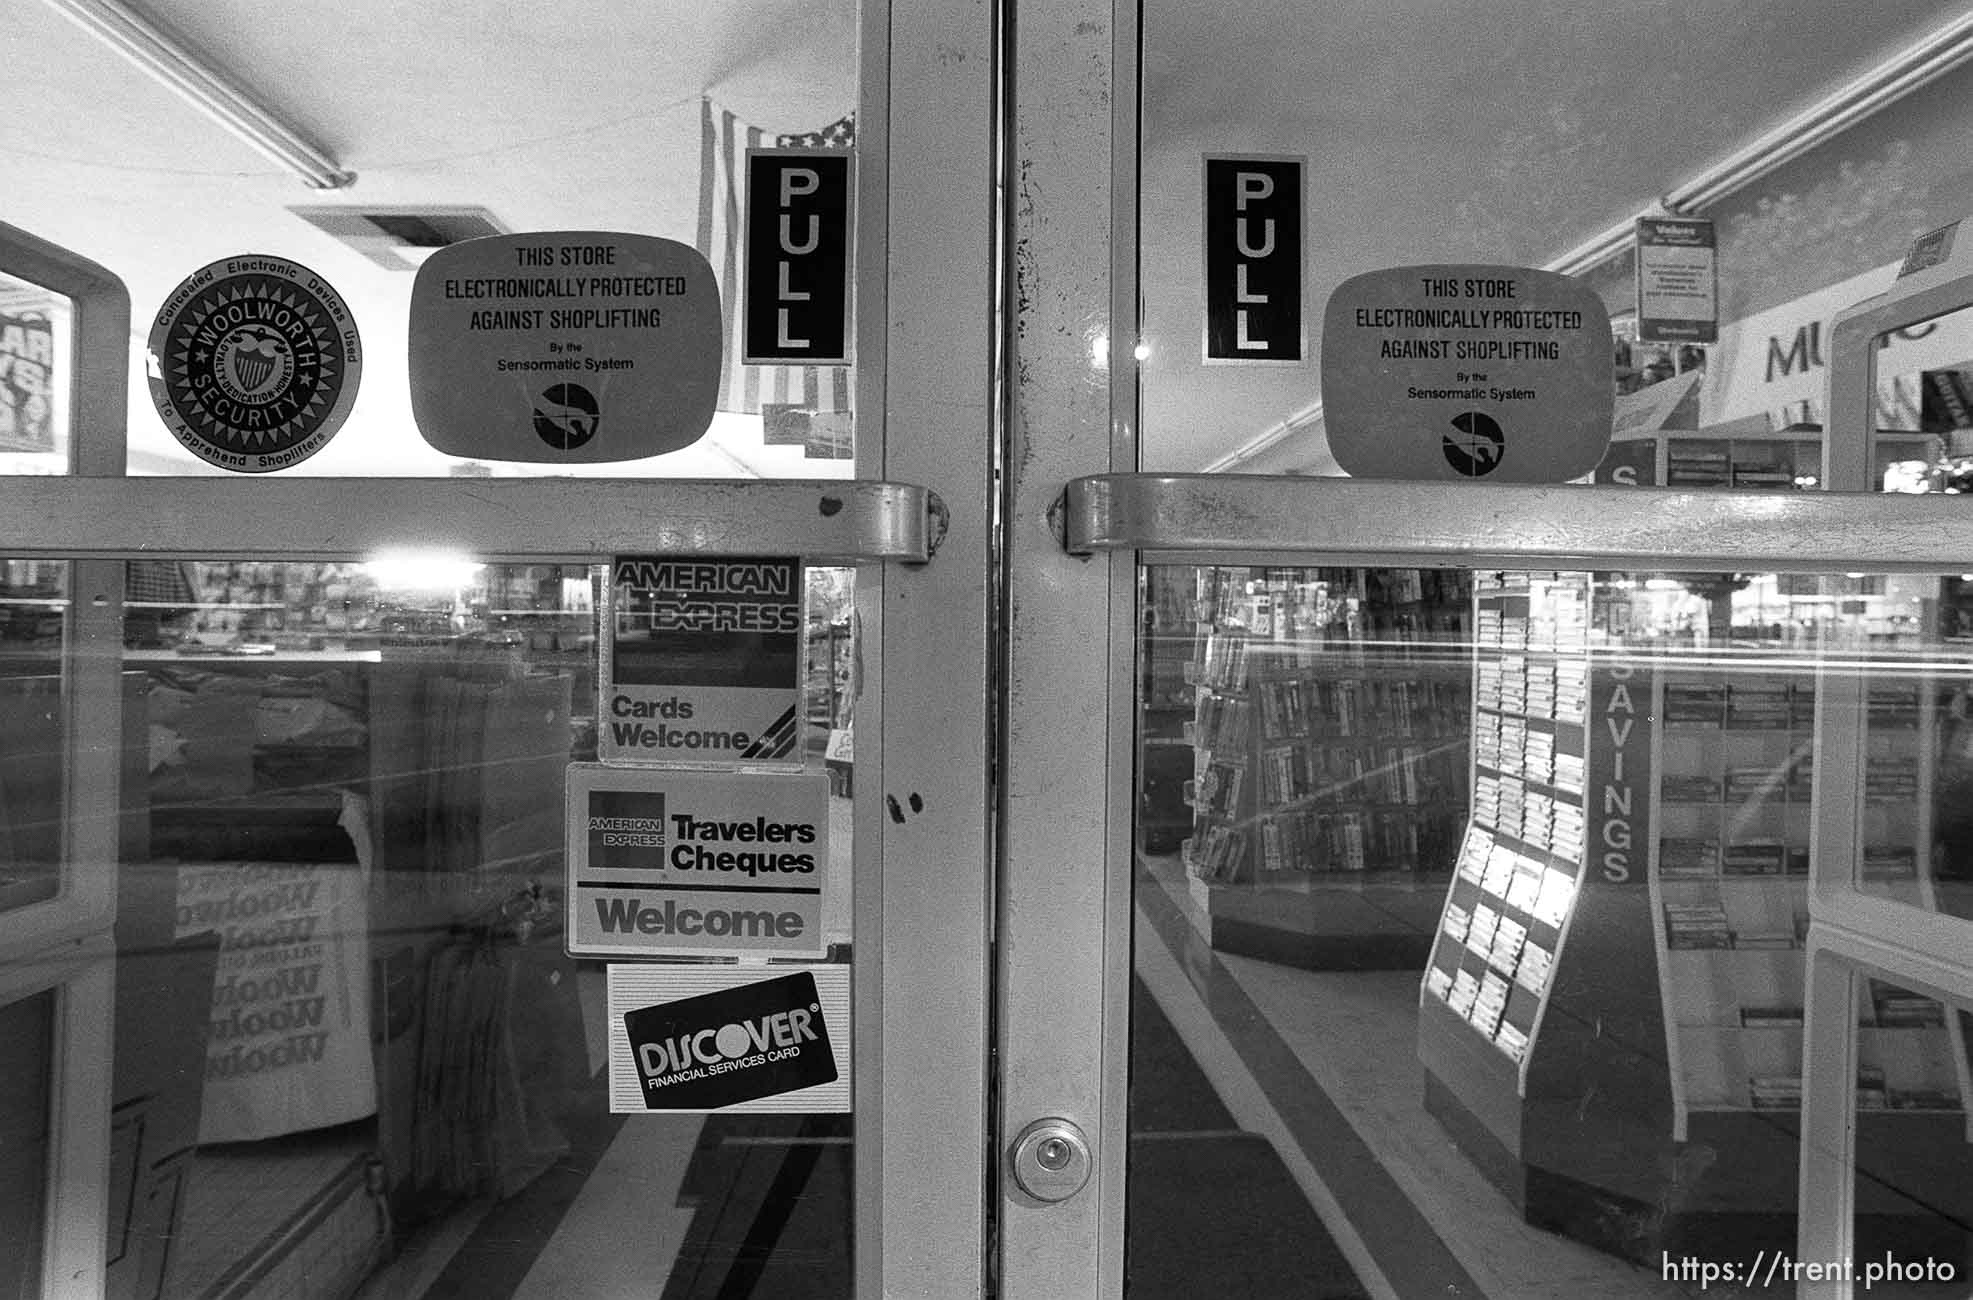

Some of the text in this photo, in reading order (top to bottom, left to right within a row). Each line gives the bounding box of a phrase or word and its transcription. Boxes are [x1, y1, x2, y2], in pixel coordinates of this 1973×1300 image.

[515, 246, 615, 266] THIS STORE
[777, 168, 819, 348] PULL
[1236, 173, 1275, 350] PULL
[446, 277, 685, 299] ELECTRONICALLY PROTECTED
[1423, 279, 1516, 298] THIS STORE
[159, 261, 358, 362] Concealed Electronic Devices Used
[470, 308, 660, 330] AGAINST SHOPLIFTING
[1356, 309, 1581, 329] ELECTRONICALLY PROTECTED
[198, 302, 317, 366] WOOLWORTH
[550, 343, 582, 354] By the
[1381, 340, 1559, 361] AGAINST SHOPLIFTING
[498, 358, 634, 373] Sensormatic System
[1457, 372, 1488, 383] By the
[194, 374, 298, 426] SECURITY
[1408, 387, 1536, 402] Sensormatic System
[161, 400, 324, 467] To Apprehend Shoplifters
[615, 561, 790, 594] AMERICAN
[651, 601, 799, 633] EXPRESS
[611, 695, 693, 719] Cards
[612, 722, 749, 750] Welcome
[588, 817, 661, 831] AMERICAN
[671, 814, 815, 843] Travelers
[604, 834, 665, 848] EXPRESS
[671, 845, 815, 877] Cheques
[595, 899, 804, 938] Welcome
[648, 1046, 801, 1090] FINANCIAL SERVICES CARD
